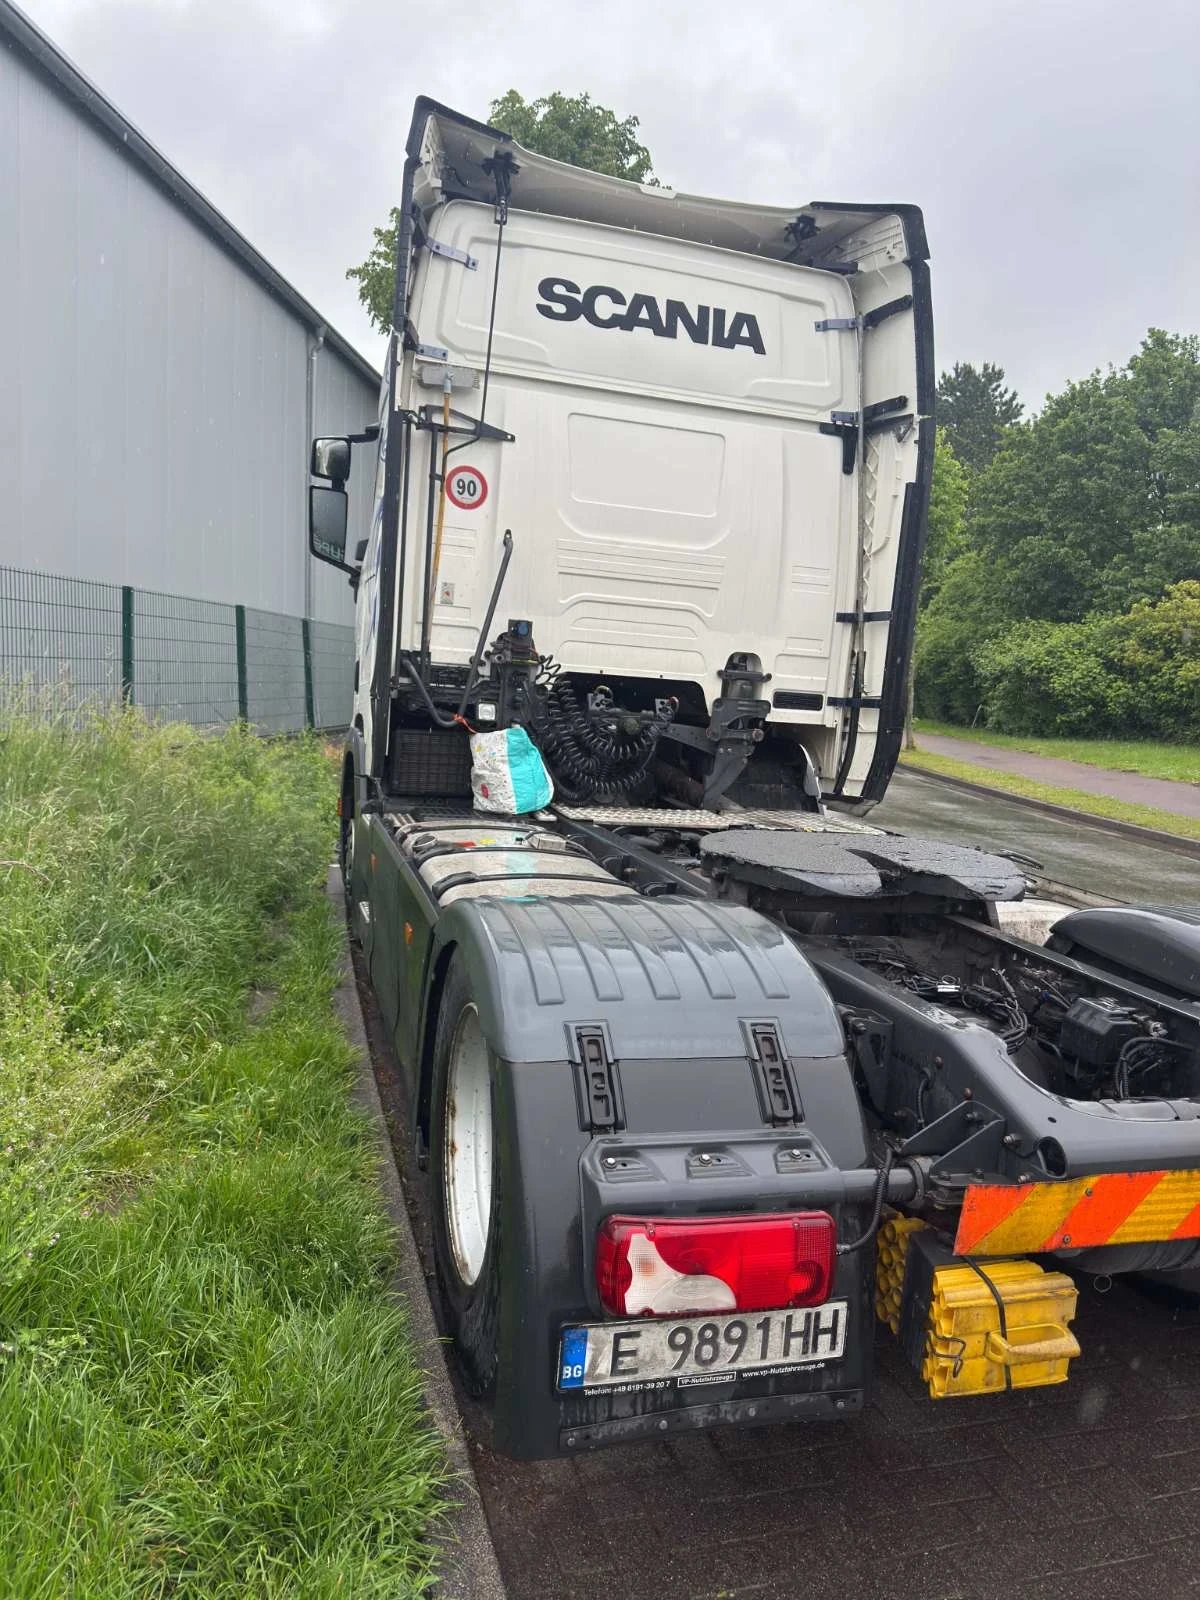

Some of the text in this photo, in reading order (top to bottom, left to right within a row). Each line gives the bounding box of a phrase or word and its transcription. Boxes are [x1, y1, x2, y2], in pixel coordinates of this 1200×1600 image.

[536, 277, 767, 355] SCANIA
[456, 478, 477, 497] 90
[610, 1330, 642, 1377] E
[562, 1364, 583, 1380] BG
